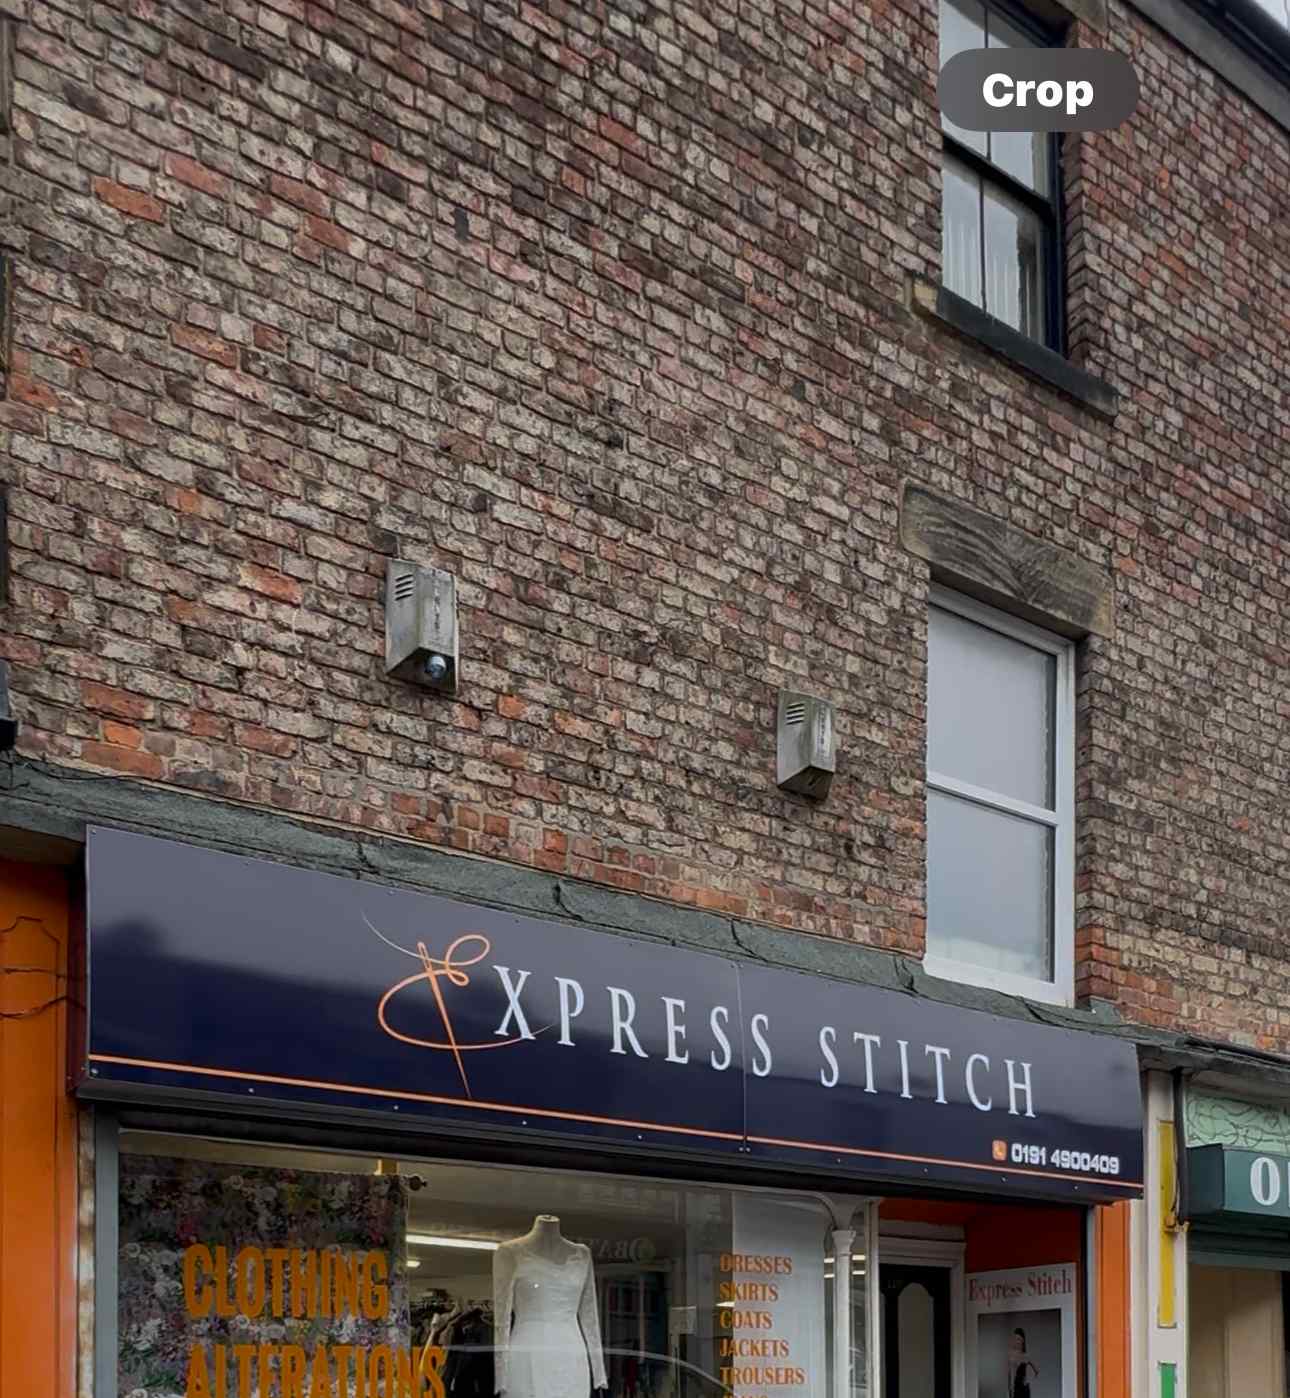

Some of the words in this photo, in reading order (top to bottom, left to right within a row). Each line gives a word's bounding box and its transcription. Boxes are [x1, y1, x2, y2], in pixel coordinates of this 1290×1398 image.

[374, 930, 773, 1098] EXPRESS
[819, 1026, 1036, 1118] STITCH
[1011, 1142, 1046, 1166] 0191
[1050, 1148, 1120, 1174] 4900409
[1250, 1156, 1290, 1208] O
[719, 1252, 793, 1275] DRESSES
[183, 1243, 390, 1320] CLOTHING
[719, 1281, 779, 1302] SKIRTS
[968, 1278, 1023, 1307] Express
[1026, 1268, 1072, 1297] Stitch
[719, 1309, 773, 1330] COATS
[719, 1337, 790, 1358] JACKETS
[719, 1365, 805, 1386] TROUSERS
